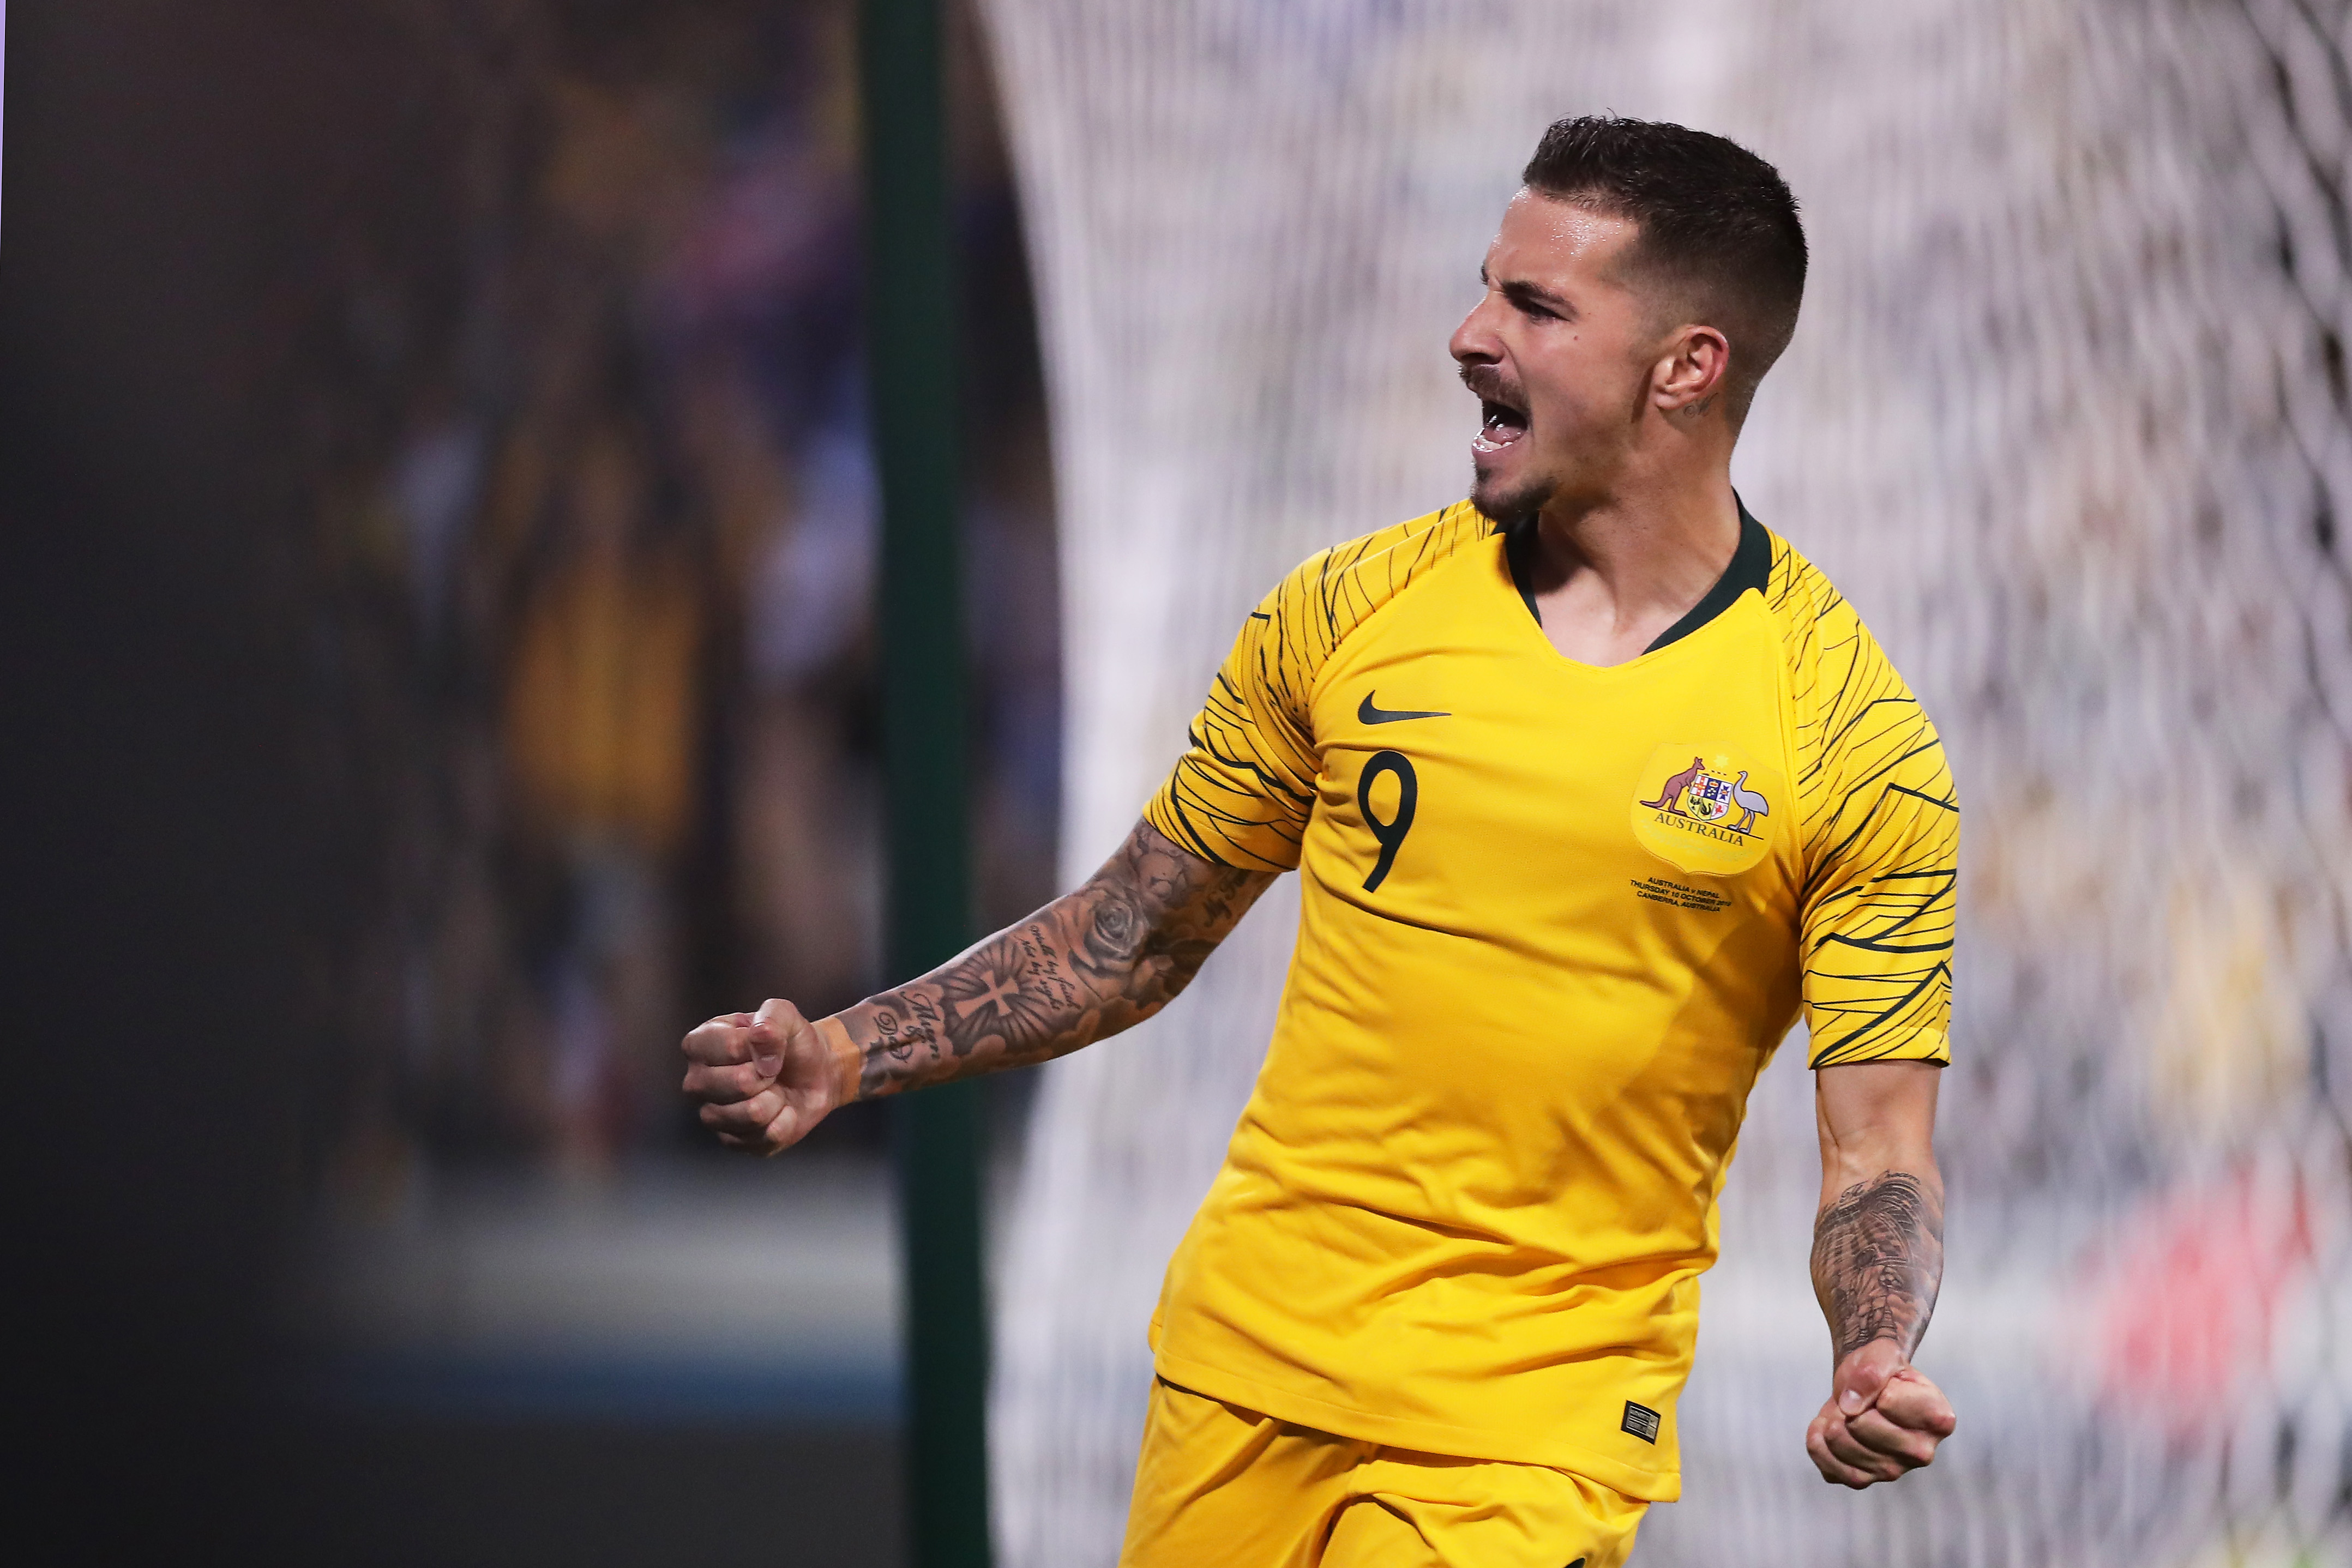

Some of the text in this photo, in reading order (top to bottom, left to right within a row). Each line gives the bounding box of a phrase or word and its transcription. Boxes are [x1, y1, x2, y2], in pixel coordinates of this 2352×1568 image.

[1358, 751, 1417, 893] 9
[1655, 813, 1743, 846] AUSTRALIA
[1630, 879, 1669, 894] THURSDAY
[1681, 893, 1716, 904] OCTOBER
[1648, 877, 1689, 892] AUSTRALIA
[1697, 889, 1719, 898] NEPAL
[1637, 891, 1721, 912] CANBERRA, AUSTRALIA
